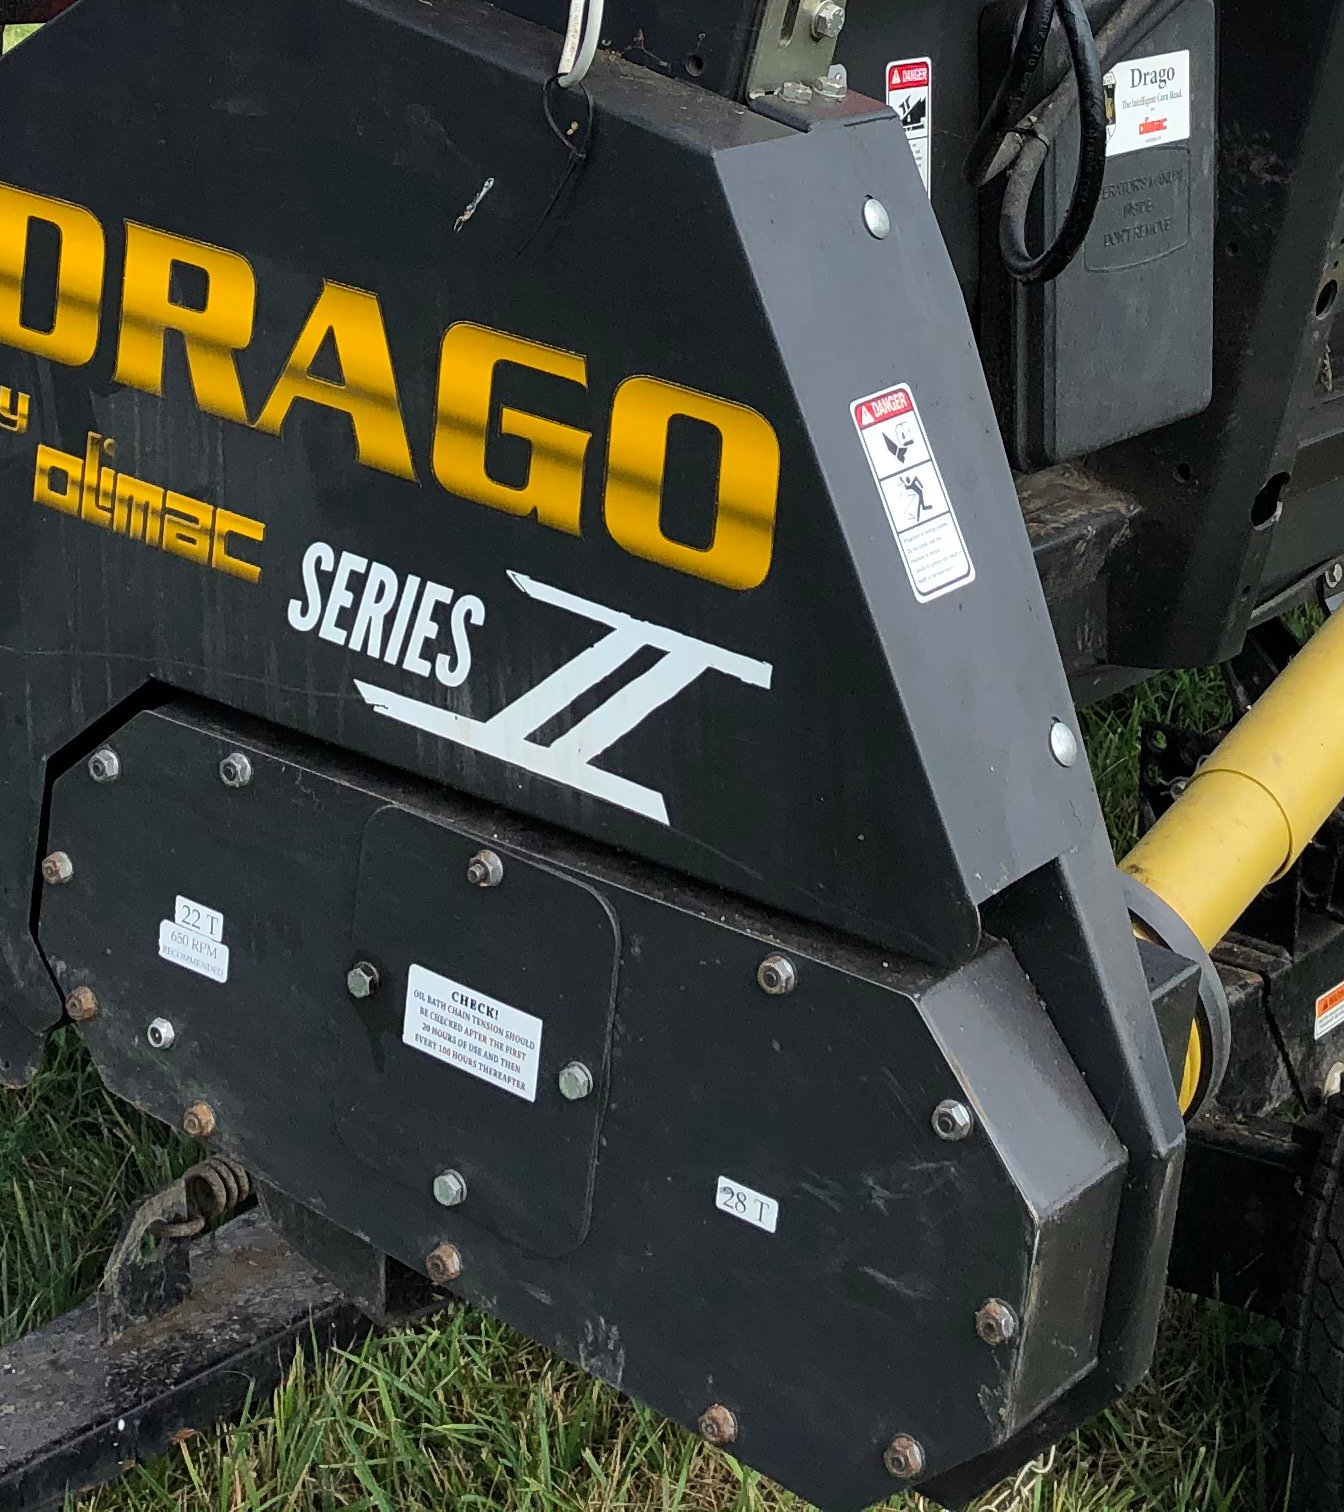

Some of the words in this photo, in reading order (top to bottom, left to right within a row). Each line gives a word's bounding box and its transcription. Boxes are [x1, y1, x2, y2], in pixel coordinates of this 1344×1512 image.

[1130, 67, 1175, 89] Drago
[872, 391, 907, 418] DANGER
[33, 431, 266, 583] olimac
[288, 541, 485, 687] SERIES
[182, 904, 201, 930] 22
[206, 914, 218, 935] T
[171, 930, 189, 946] 650
[192, 938, 217, 959] RPM
[413, 989, 426, 1002] OIL
[427, 995, 446, 1010] BATH
[447, 1004, 471, 1021] CHAIN
[472, 1014, 505, 1036] TENSION
[505, 1030, 536, 1050] SHOULD
[451, 991, 499, 1021] CHECK!
[419, 1006, 429, 1016] BE
[429, 1010, 463, 1033] CHECKED
[463, 1025, 488, 1045] AFTER
[489, 1037, 504, 1051] THE
[505, 1044, 527, 1061] FIRST
[422, 1022, 431, 1033] 20
[431, 1025, 457, 1044] HOURS
[457, 1038, 468, 1050] OF
[468, 1043, 482, 1057] USE
[483, 1050, 498, 1064] AND
[500, 1058, 521, 1074] THEN
[415, 1033, 437, 1050] EVERY
[438, 1043, 451, 1056] 100
[452, 1051, 477, 1068] HOURS
[478, 1062, 526, 1092] THEREAFTER
[722, 1186, 747, 1213] 28
[754, 1199, 770, 1223] T
